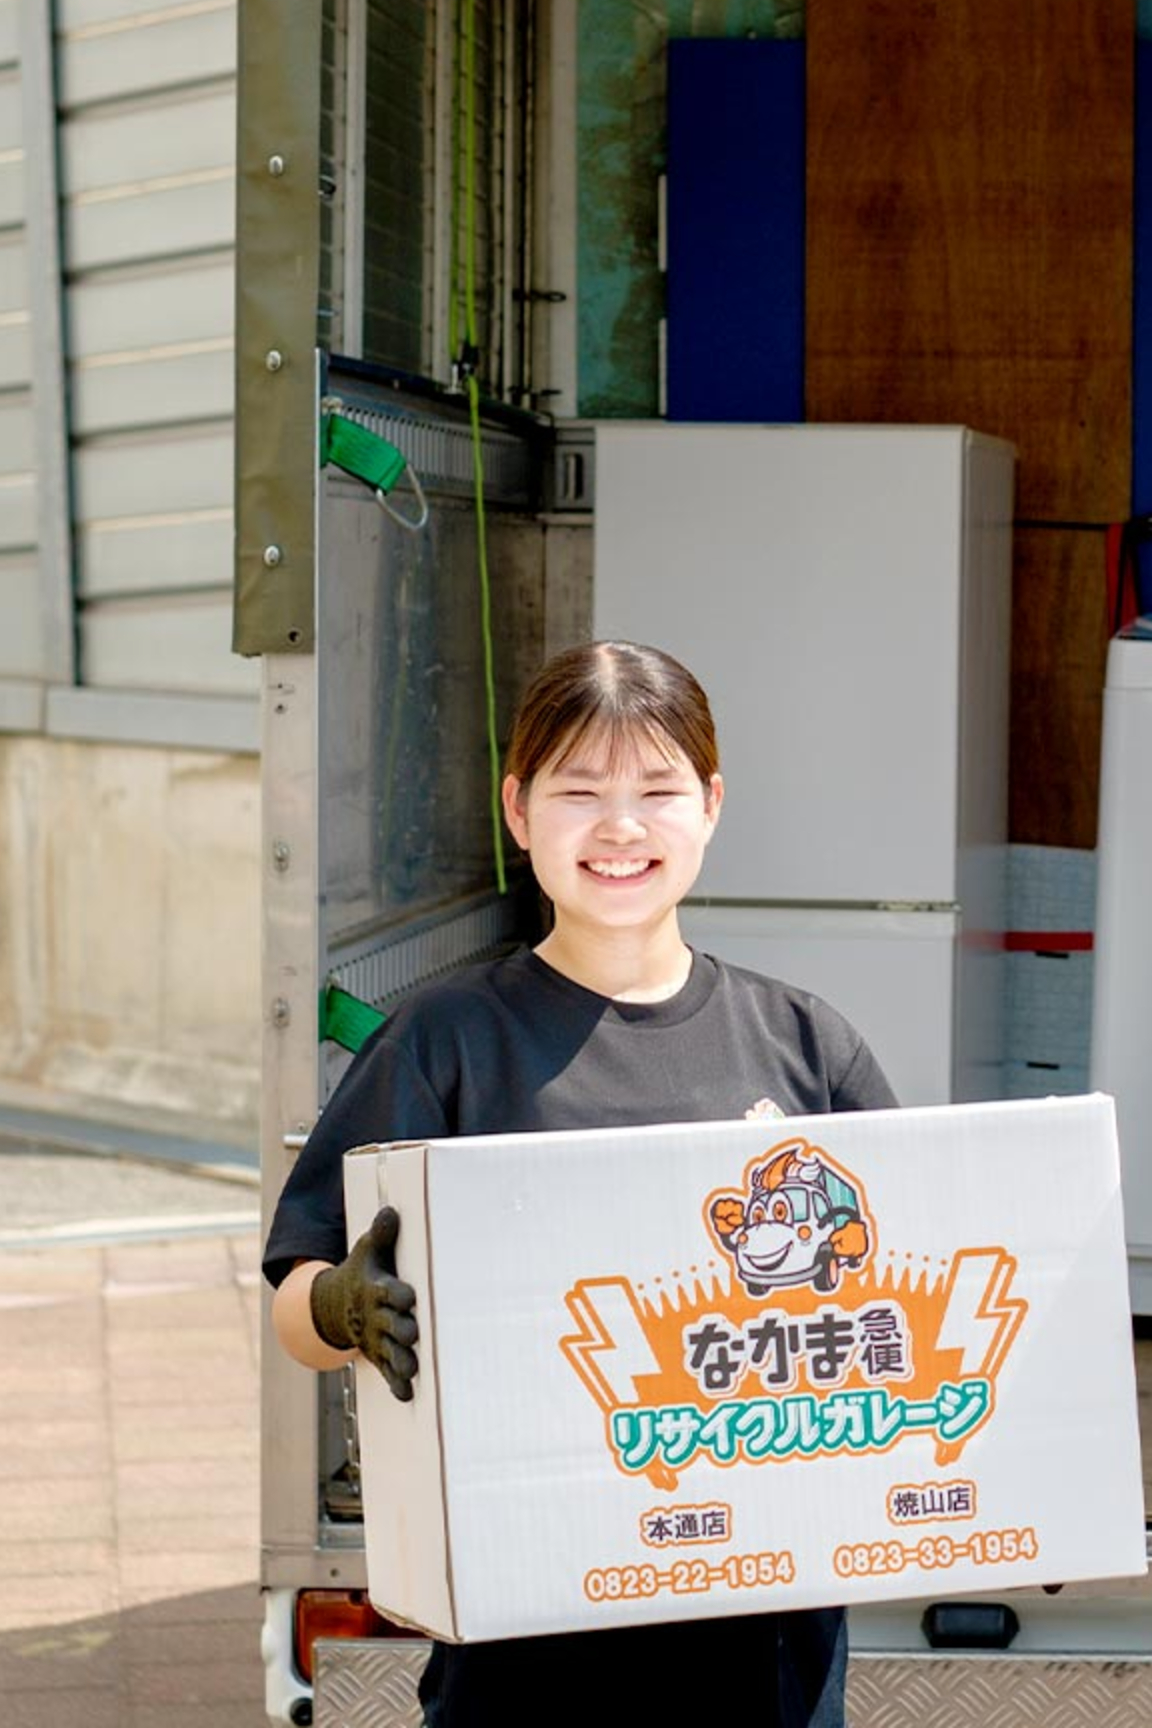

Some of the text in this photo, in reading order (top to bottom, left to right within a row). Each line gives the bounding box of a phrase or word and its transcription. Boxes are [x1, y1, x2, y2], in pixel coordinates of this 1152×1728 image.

[613, 1381, 990, 1468] リサイクルガレージ
[646, 1509, 727, 1541] 本通店
[893, 1487, 971, 1517] 焼山店
[835, 1530, 1037, 1576] 0823-33-1954
[585, 1554, 794, 1600] 0823-22-1954
